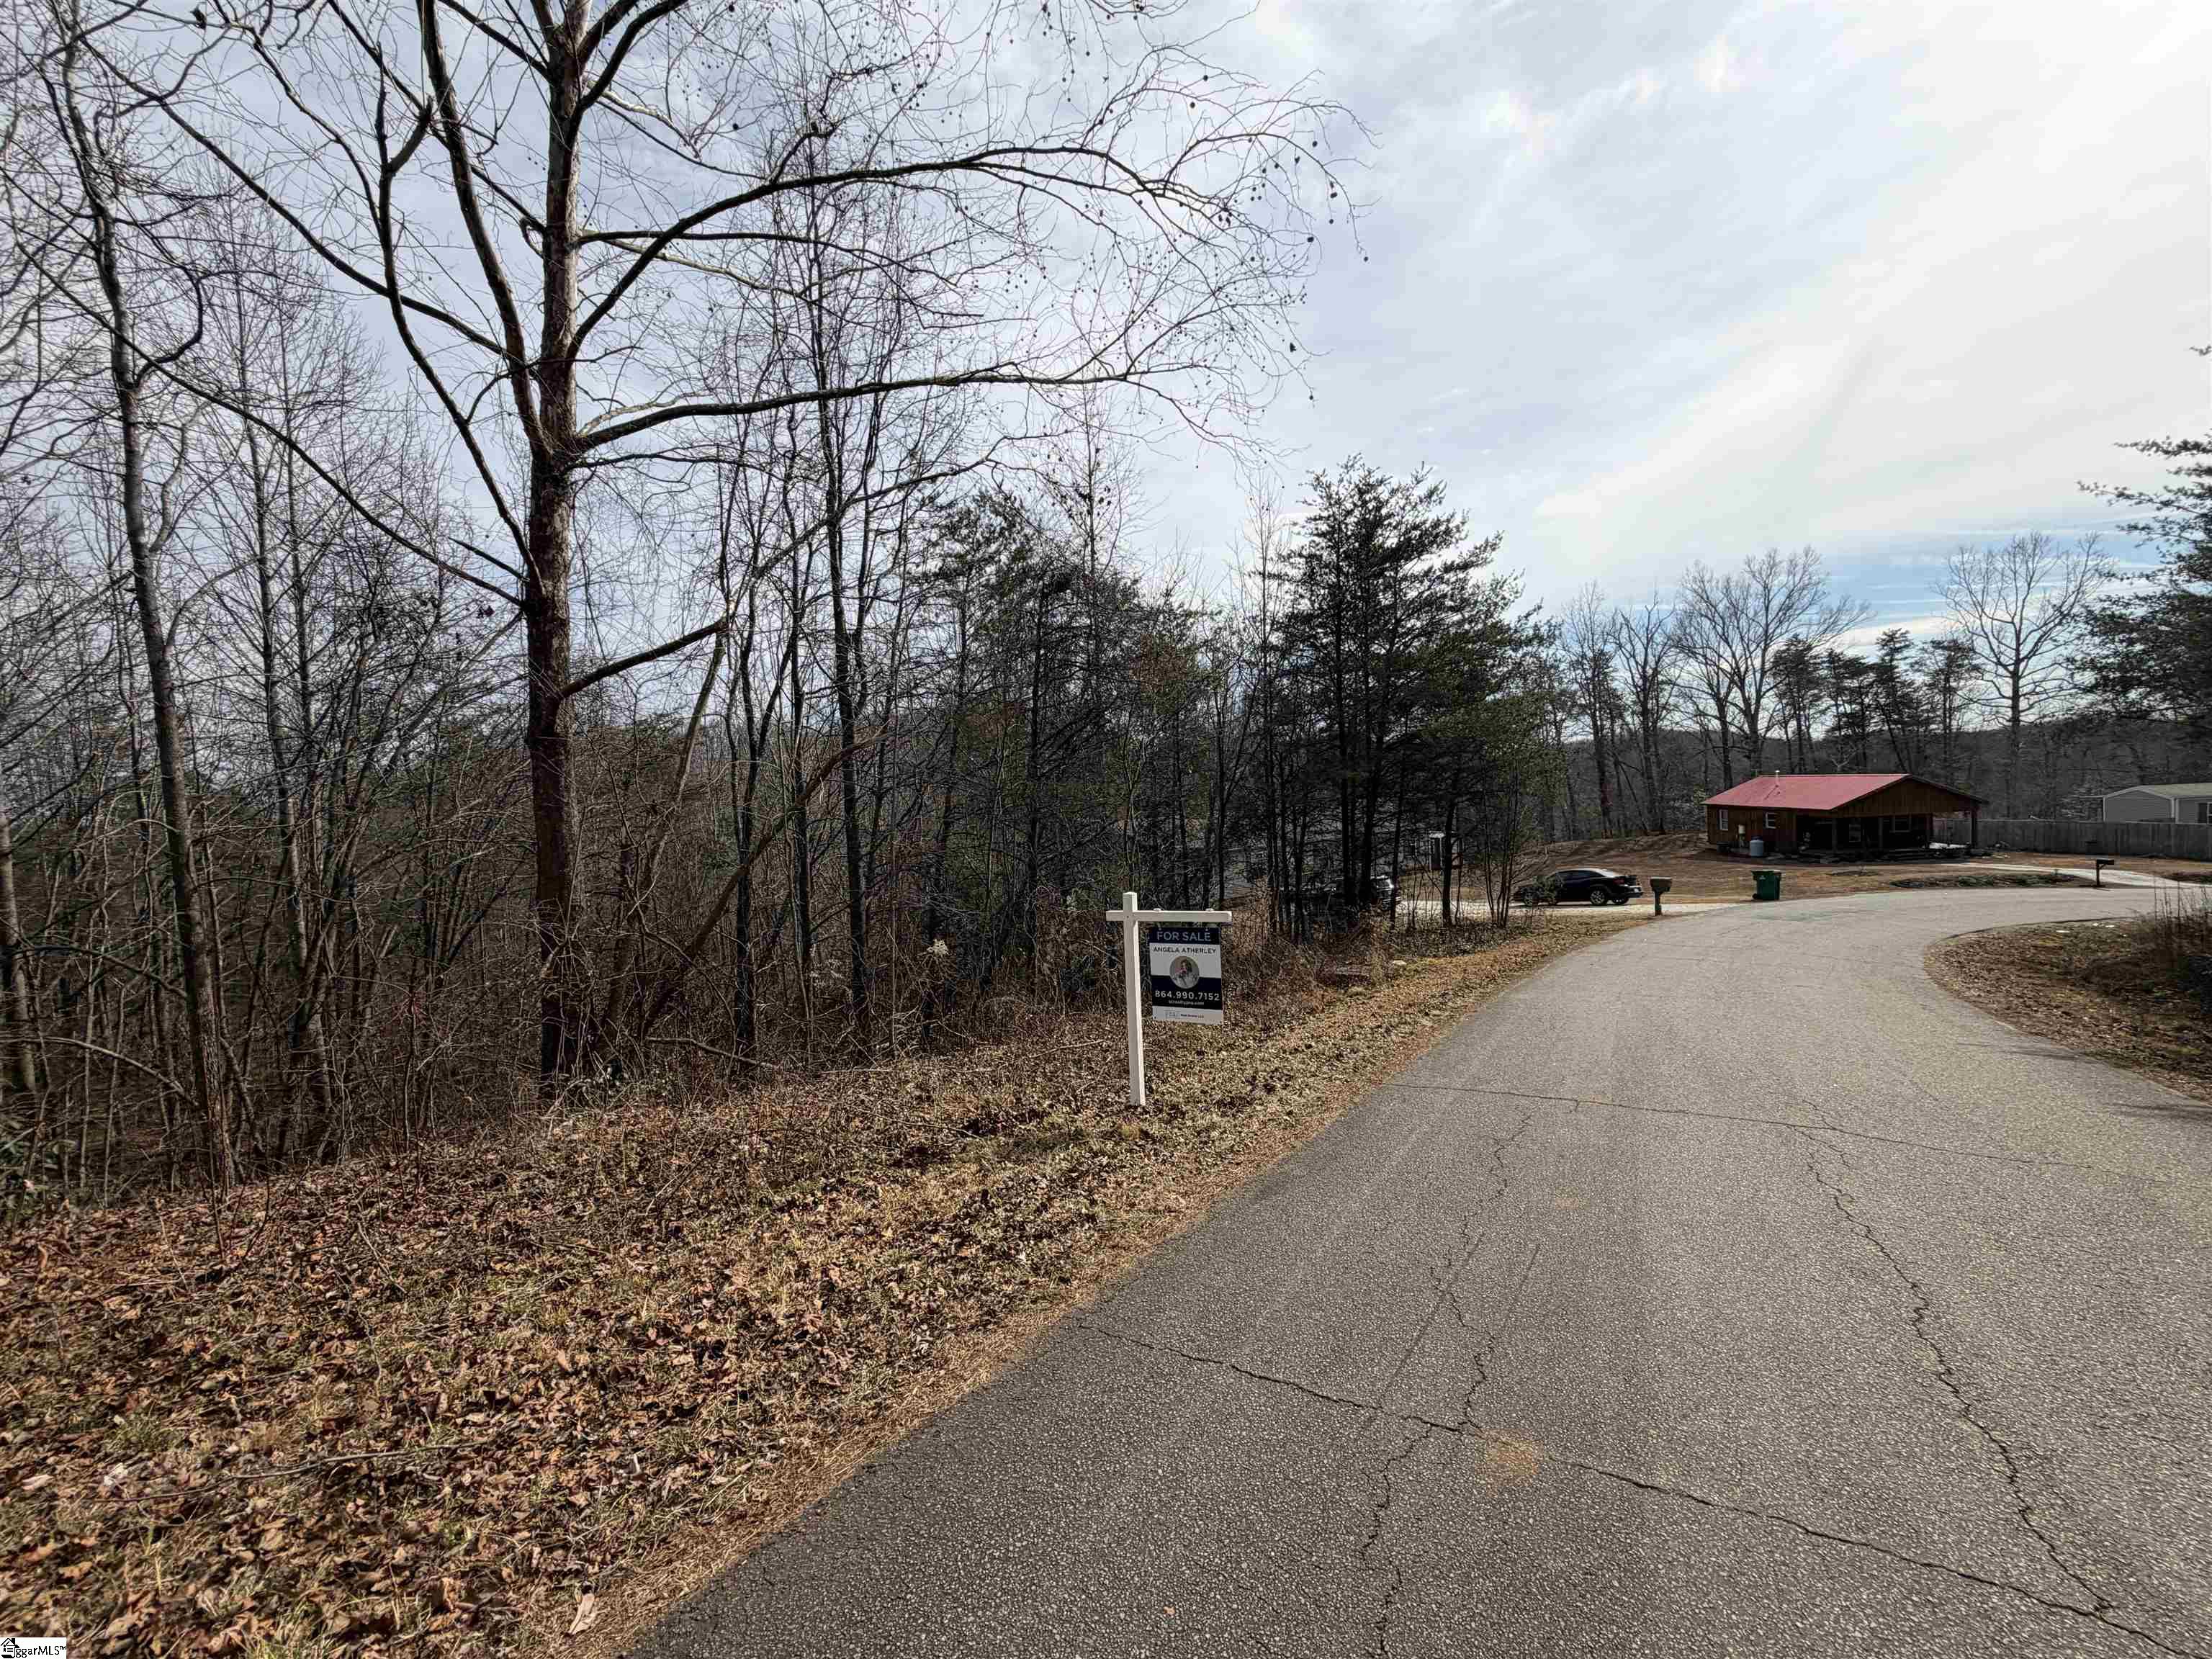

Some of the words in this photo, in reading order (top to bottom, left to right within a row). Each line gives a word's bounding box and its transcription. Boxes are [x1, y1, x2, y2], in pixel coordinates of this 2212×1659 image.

[1157, 931, 1179, 940] FOR
[1182, 932, 1211, 941] SALE
[1155, 990, 1220, 1001] 864.990.7152
